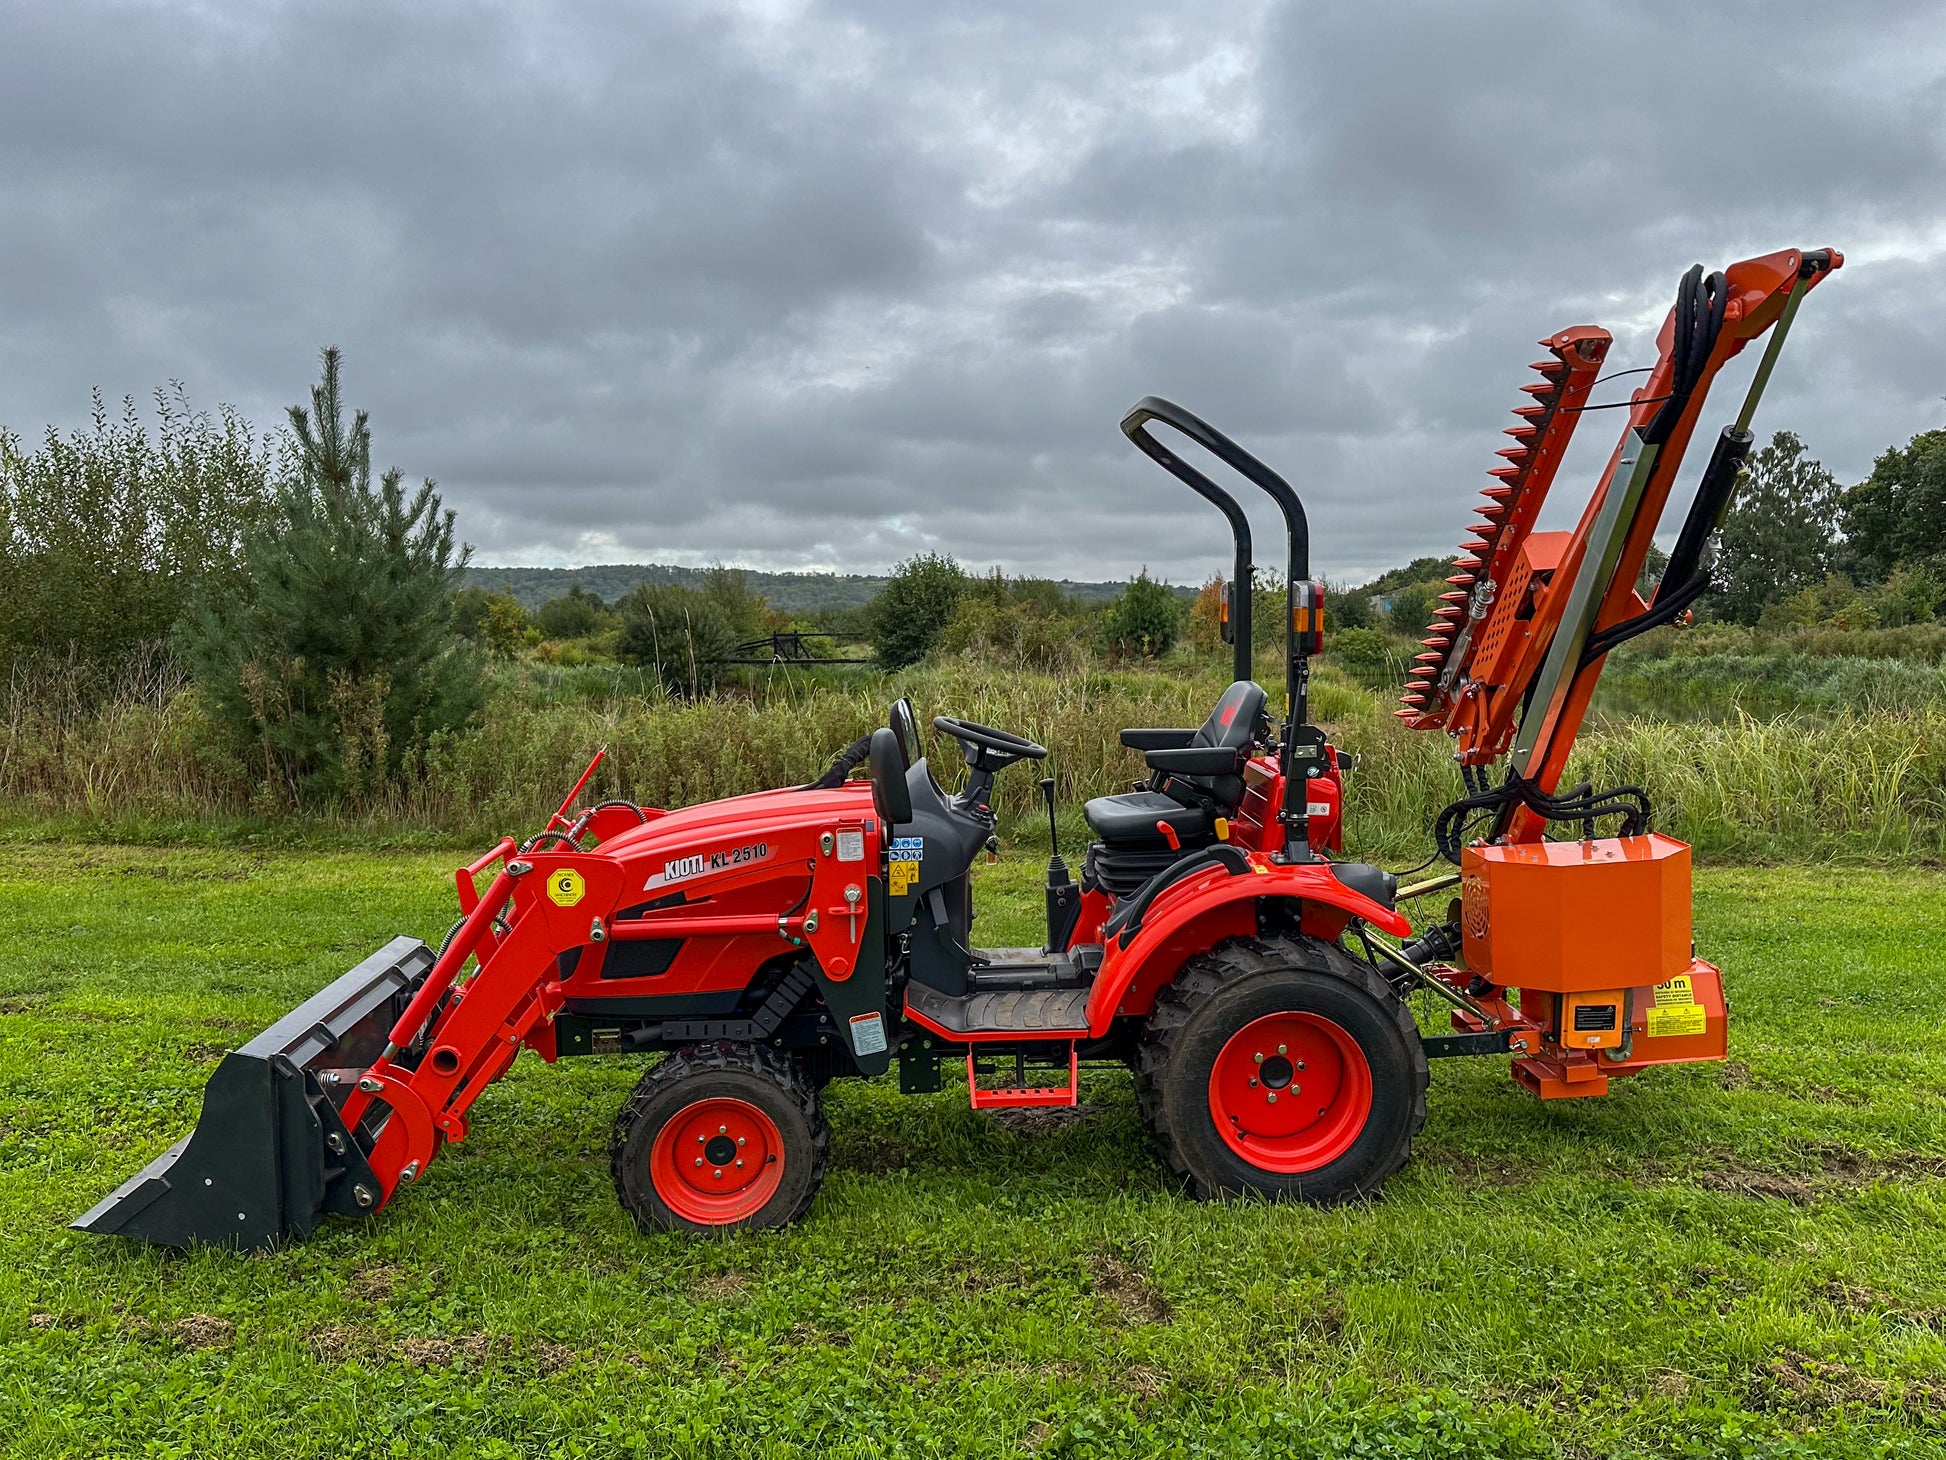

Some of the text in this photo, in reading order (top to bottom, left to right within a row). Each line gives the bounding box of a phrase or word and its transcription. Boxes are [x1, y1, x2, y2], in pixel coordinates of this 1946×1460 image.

[665, 843, 767, 881] KIOTI KL 2510
[1674, 980, 1686, 989] m
